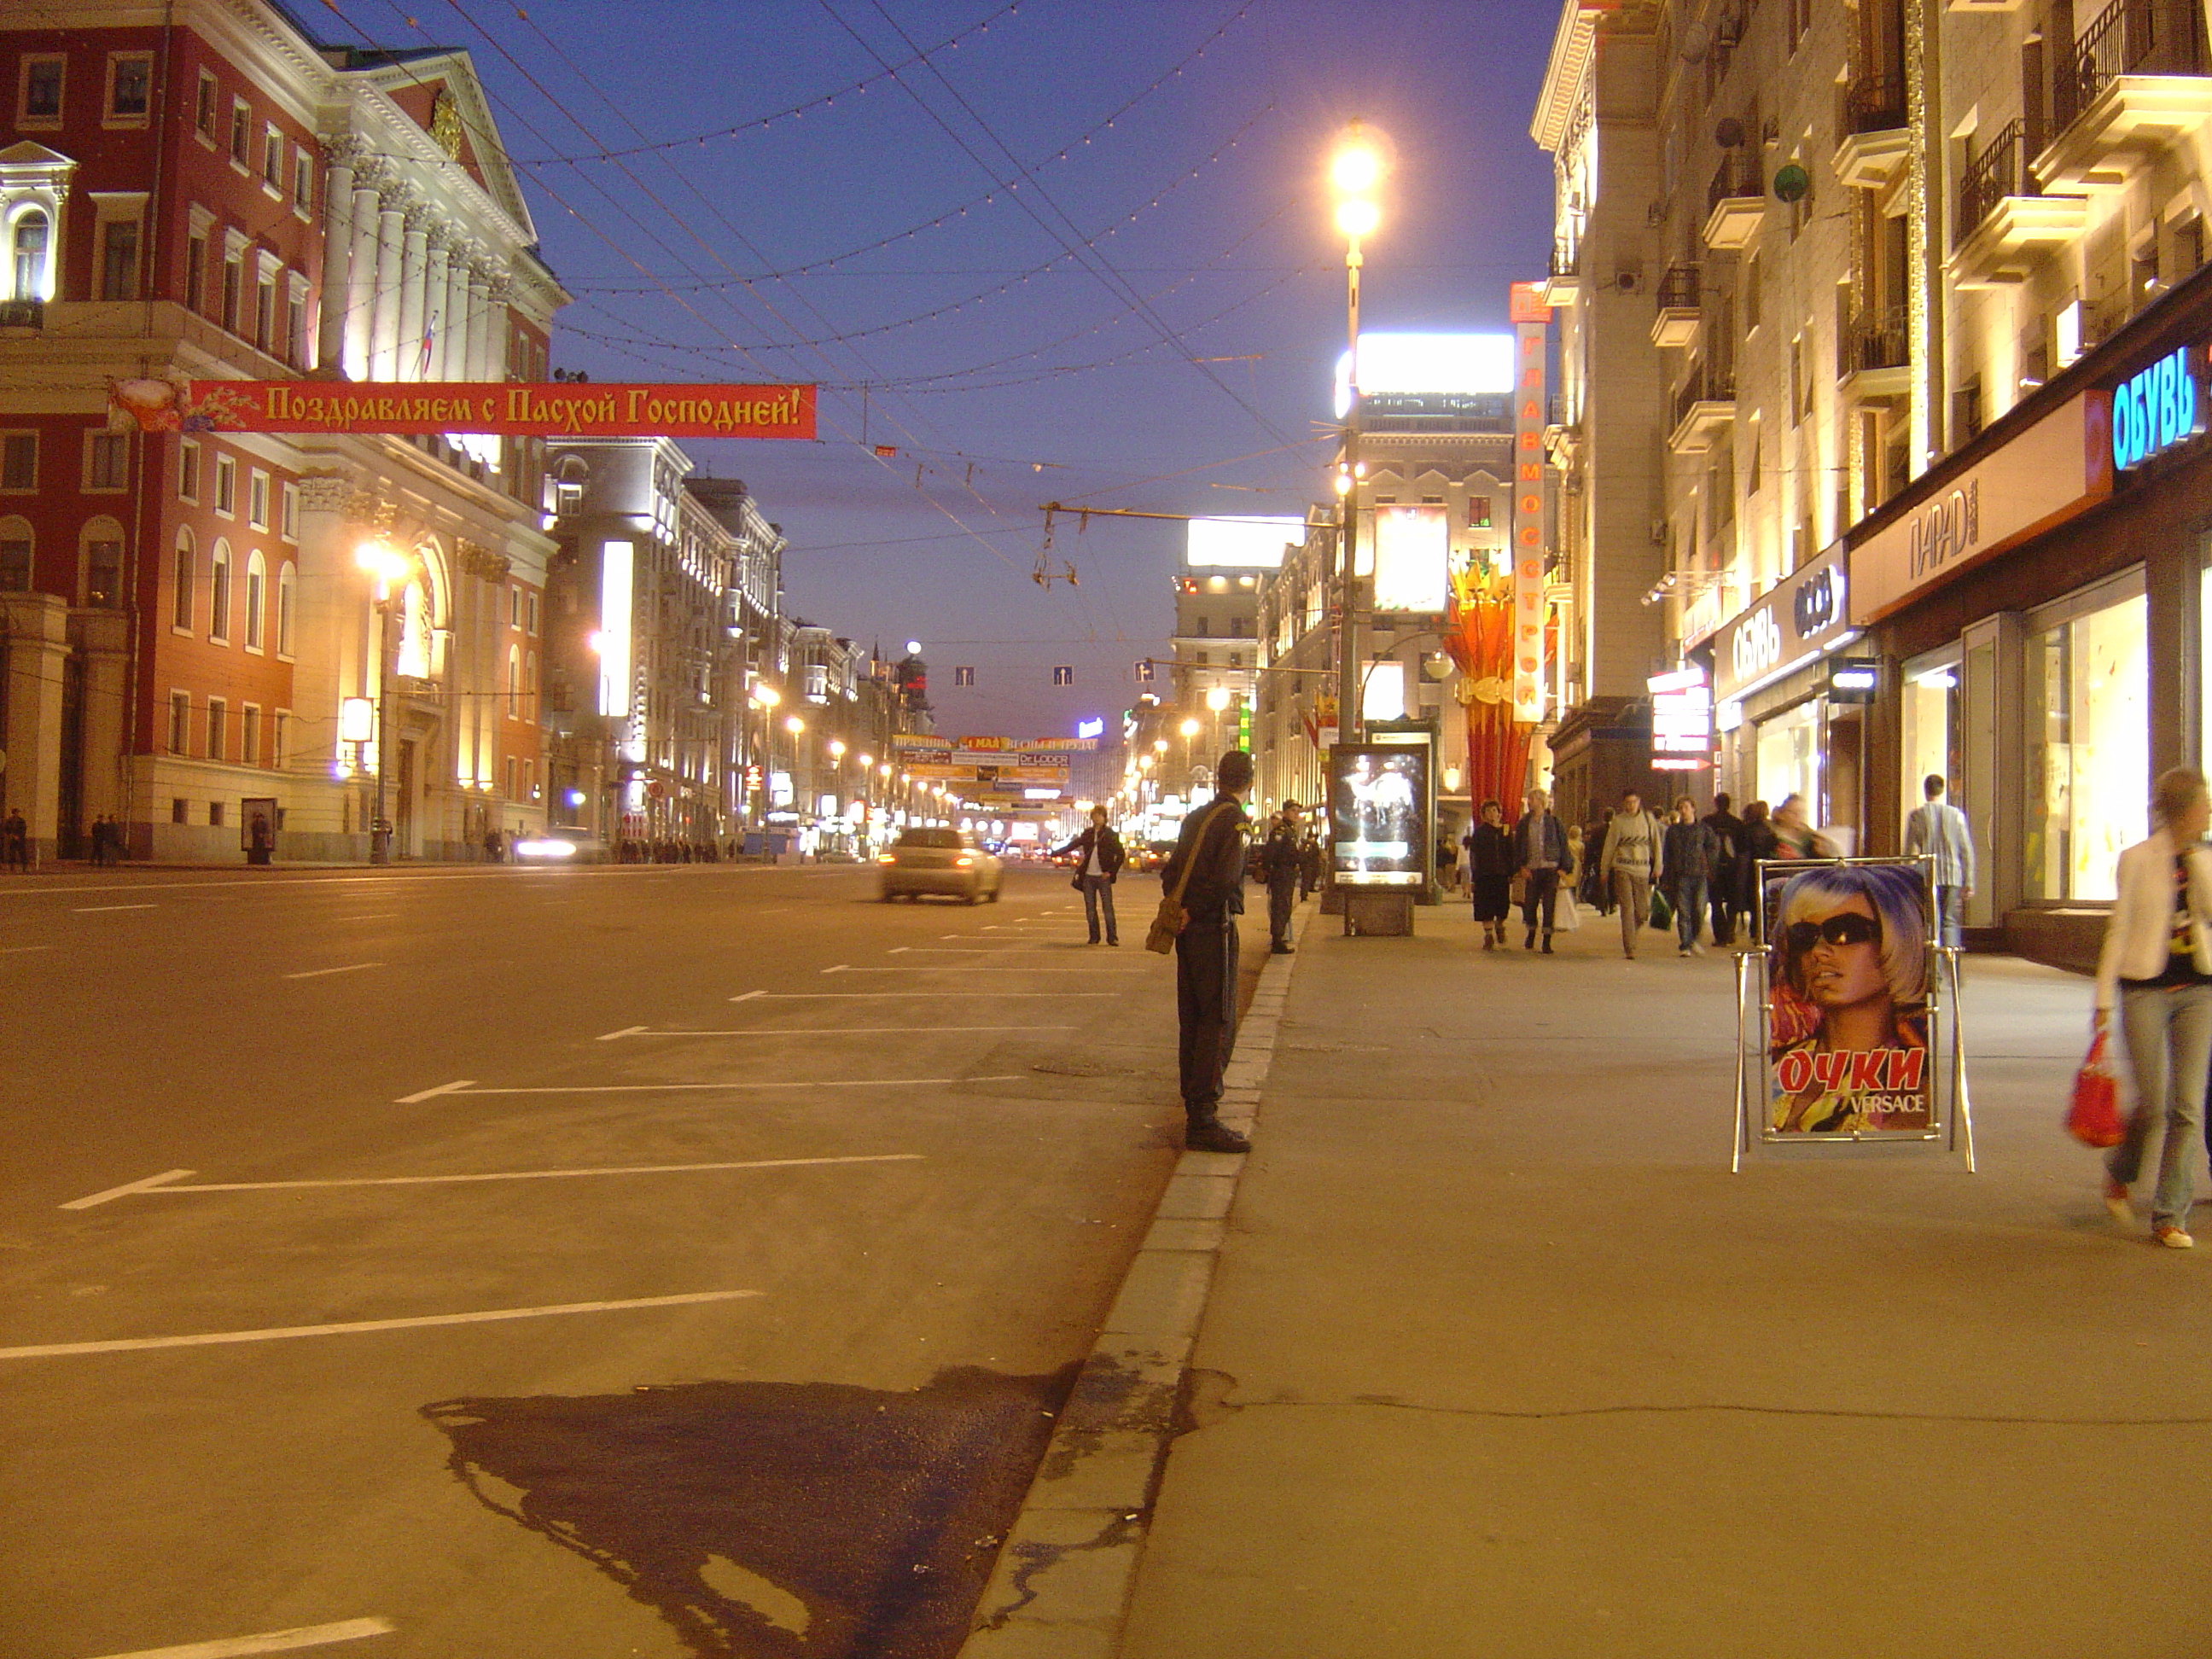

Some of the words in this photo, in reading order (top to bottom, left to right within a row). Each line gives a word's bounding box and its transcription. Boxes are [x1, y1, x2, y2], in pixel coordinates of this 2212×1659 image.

[265, 387, 473, 430] Поздравляем
[482, 398, 495, 422] с
[506, 389, 616, 433] Пасхой
[626, 388, 800, 431] Господней!
[2112, 346, 2194, 471] ОБУВЬ
[1516, 336, 1542, 706] ГЛАВМОССТРОЙ
[1732, 603, 1780, 683] ОБУВЬ
[1778, 1047, 1925, 1093] ОЧКИ
[1851, 1094, 1925, 1114] VERSACE
